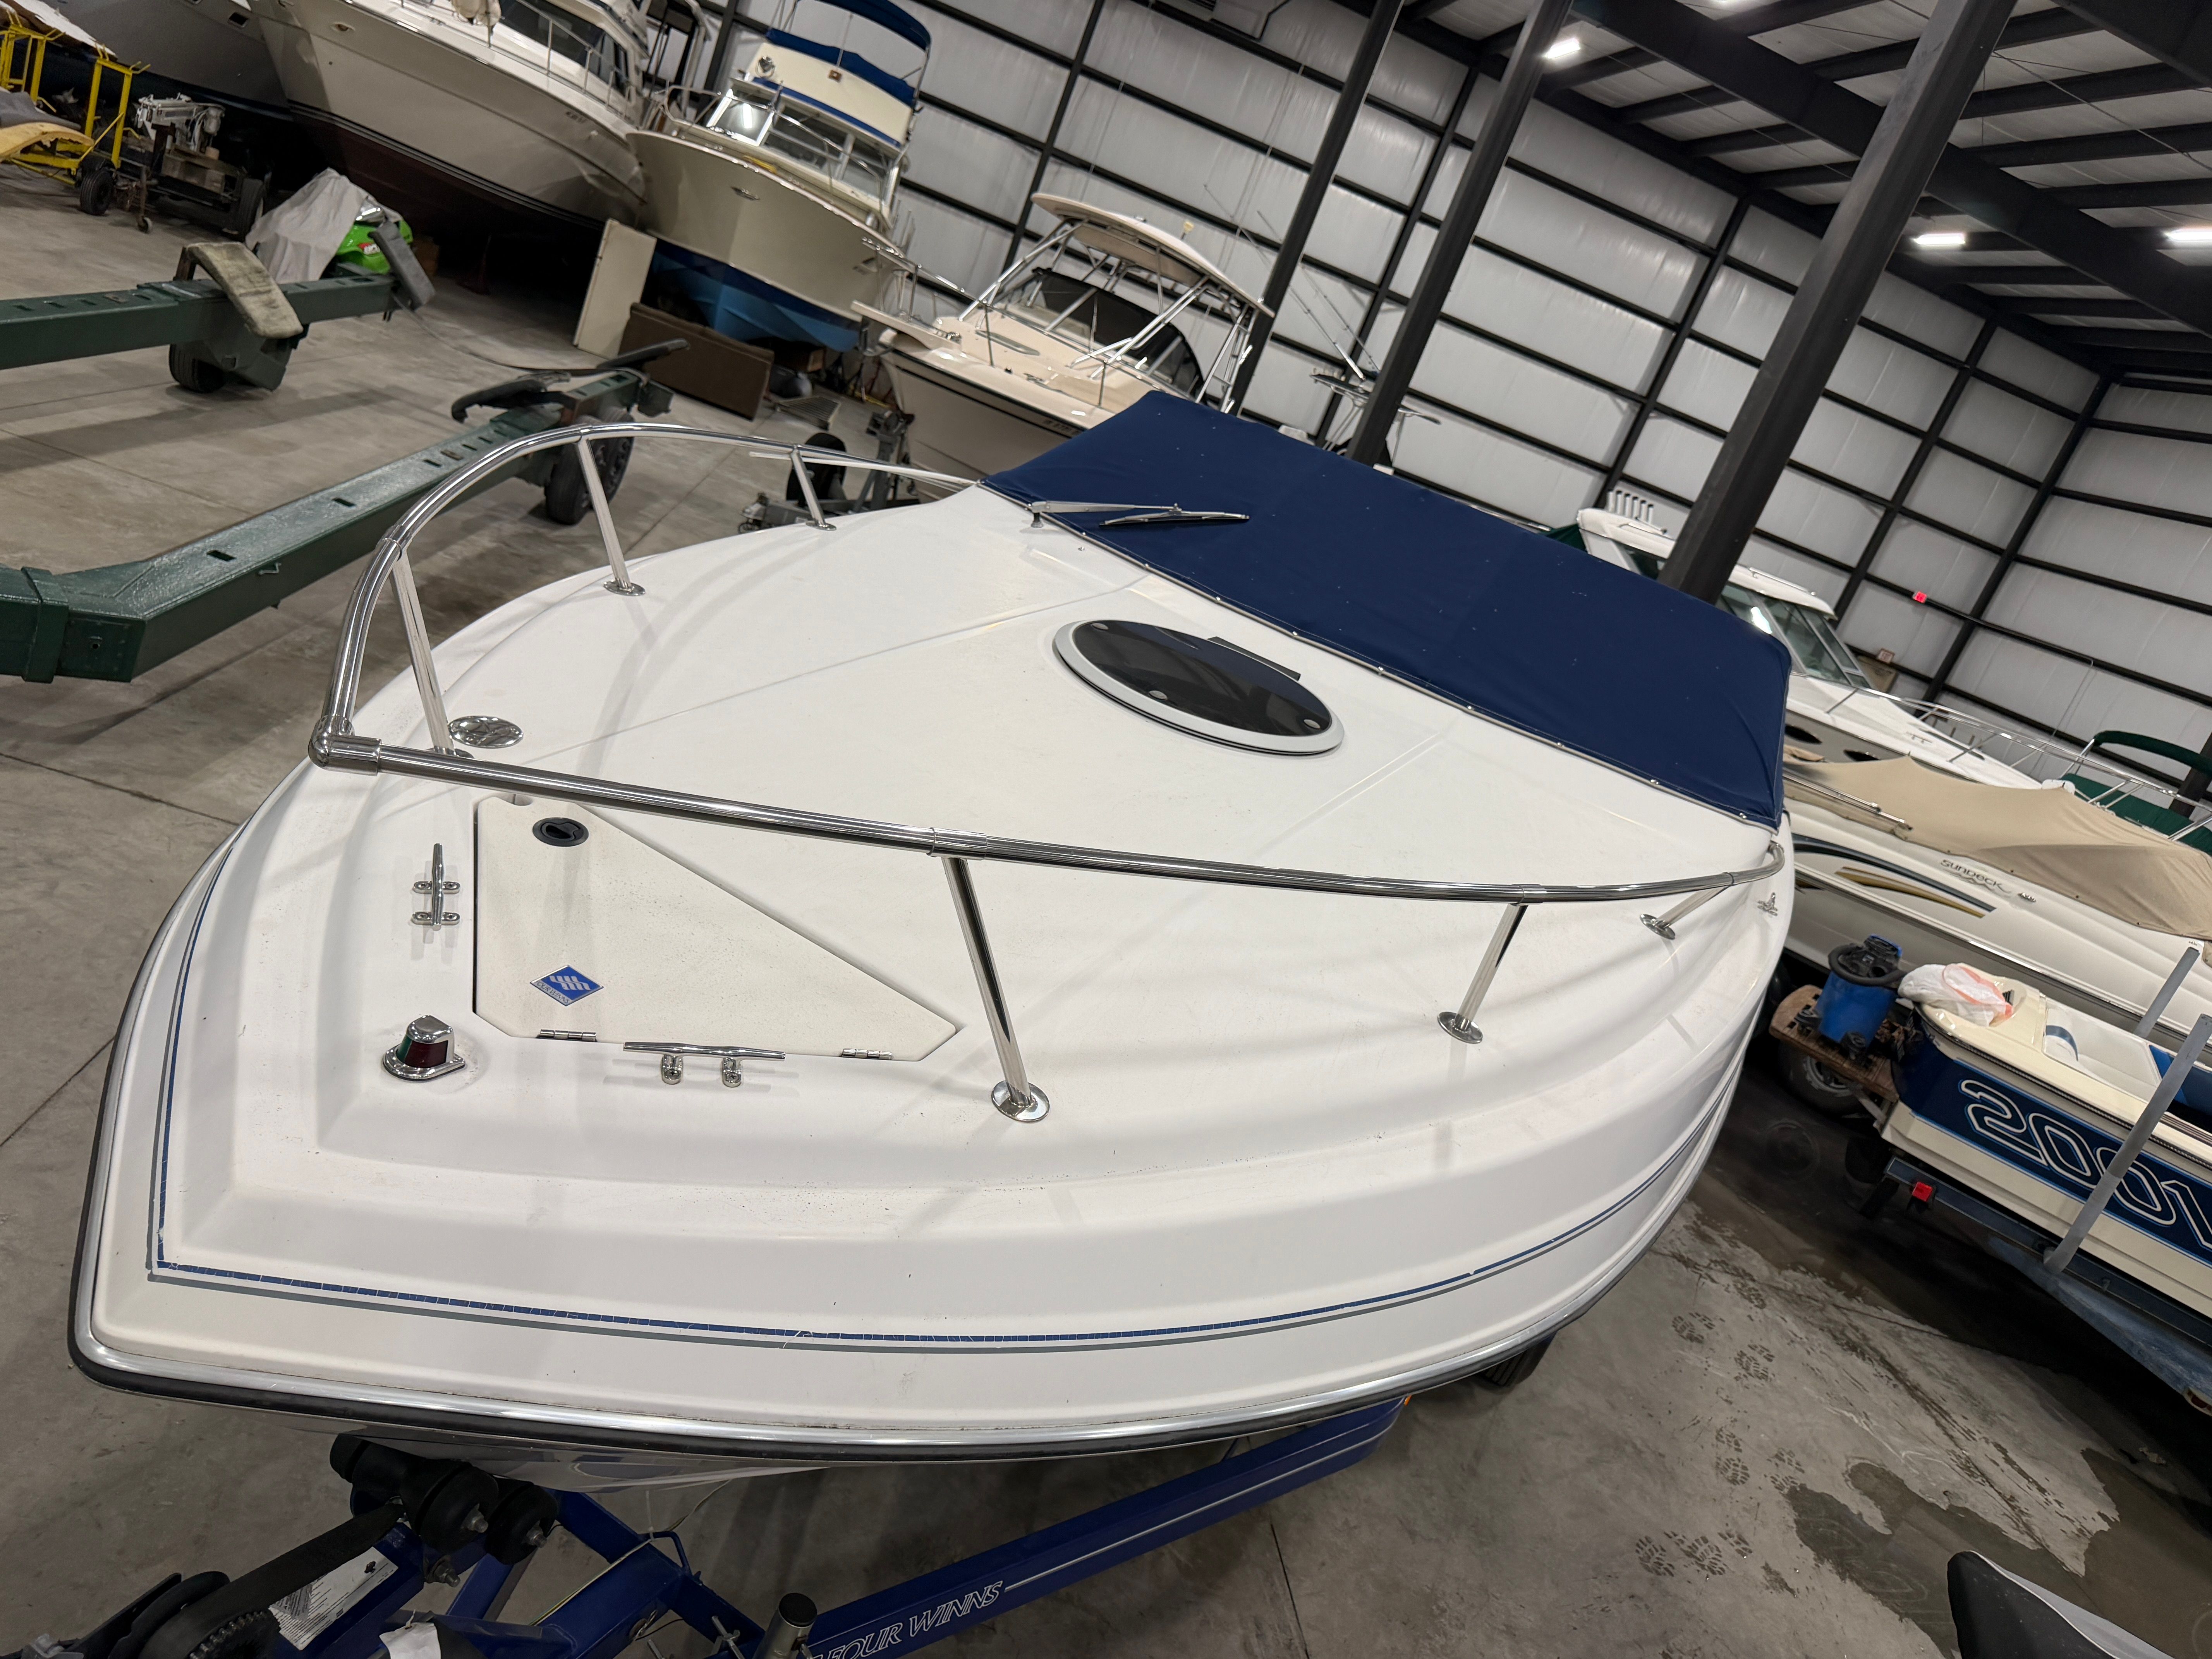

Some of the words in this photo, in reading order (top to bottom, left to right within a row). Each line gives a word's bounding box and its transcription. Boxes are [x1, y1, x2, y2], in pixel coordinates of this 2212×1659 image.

[550, 989, 570, 1004] WINNS
[1959, 1079, 2212, 1249] 2001
[909, 1580, 1003, 1637] WINNS
